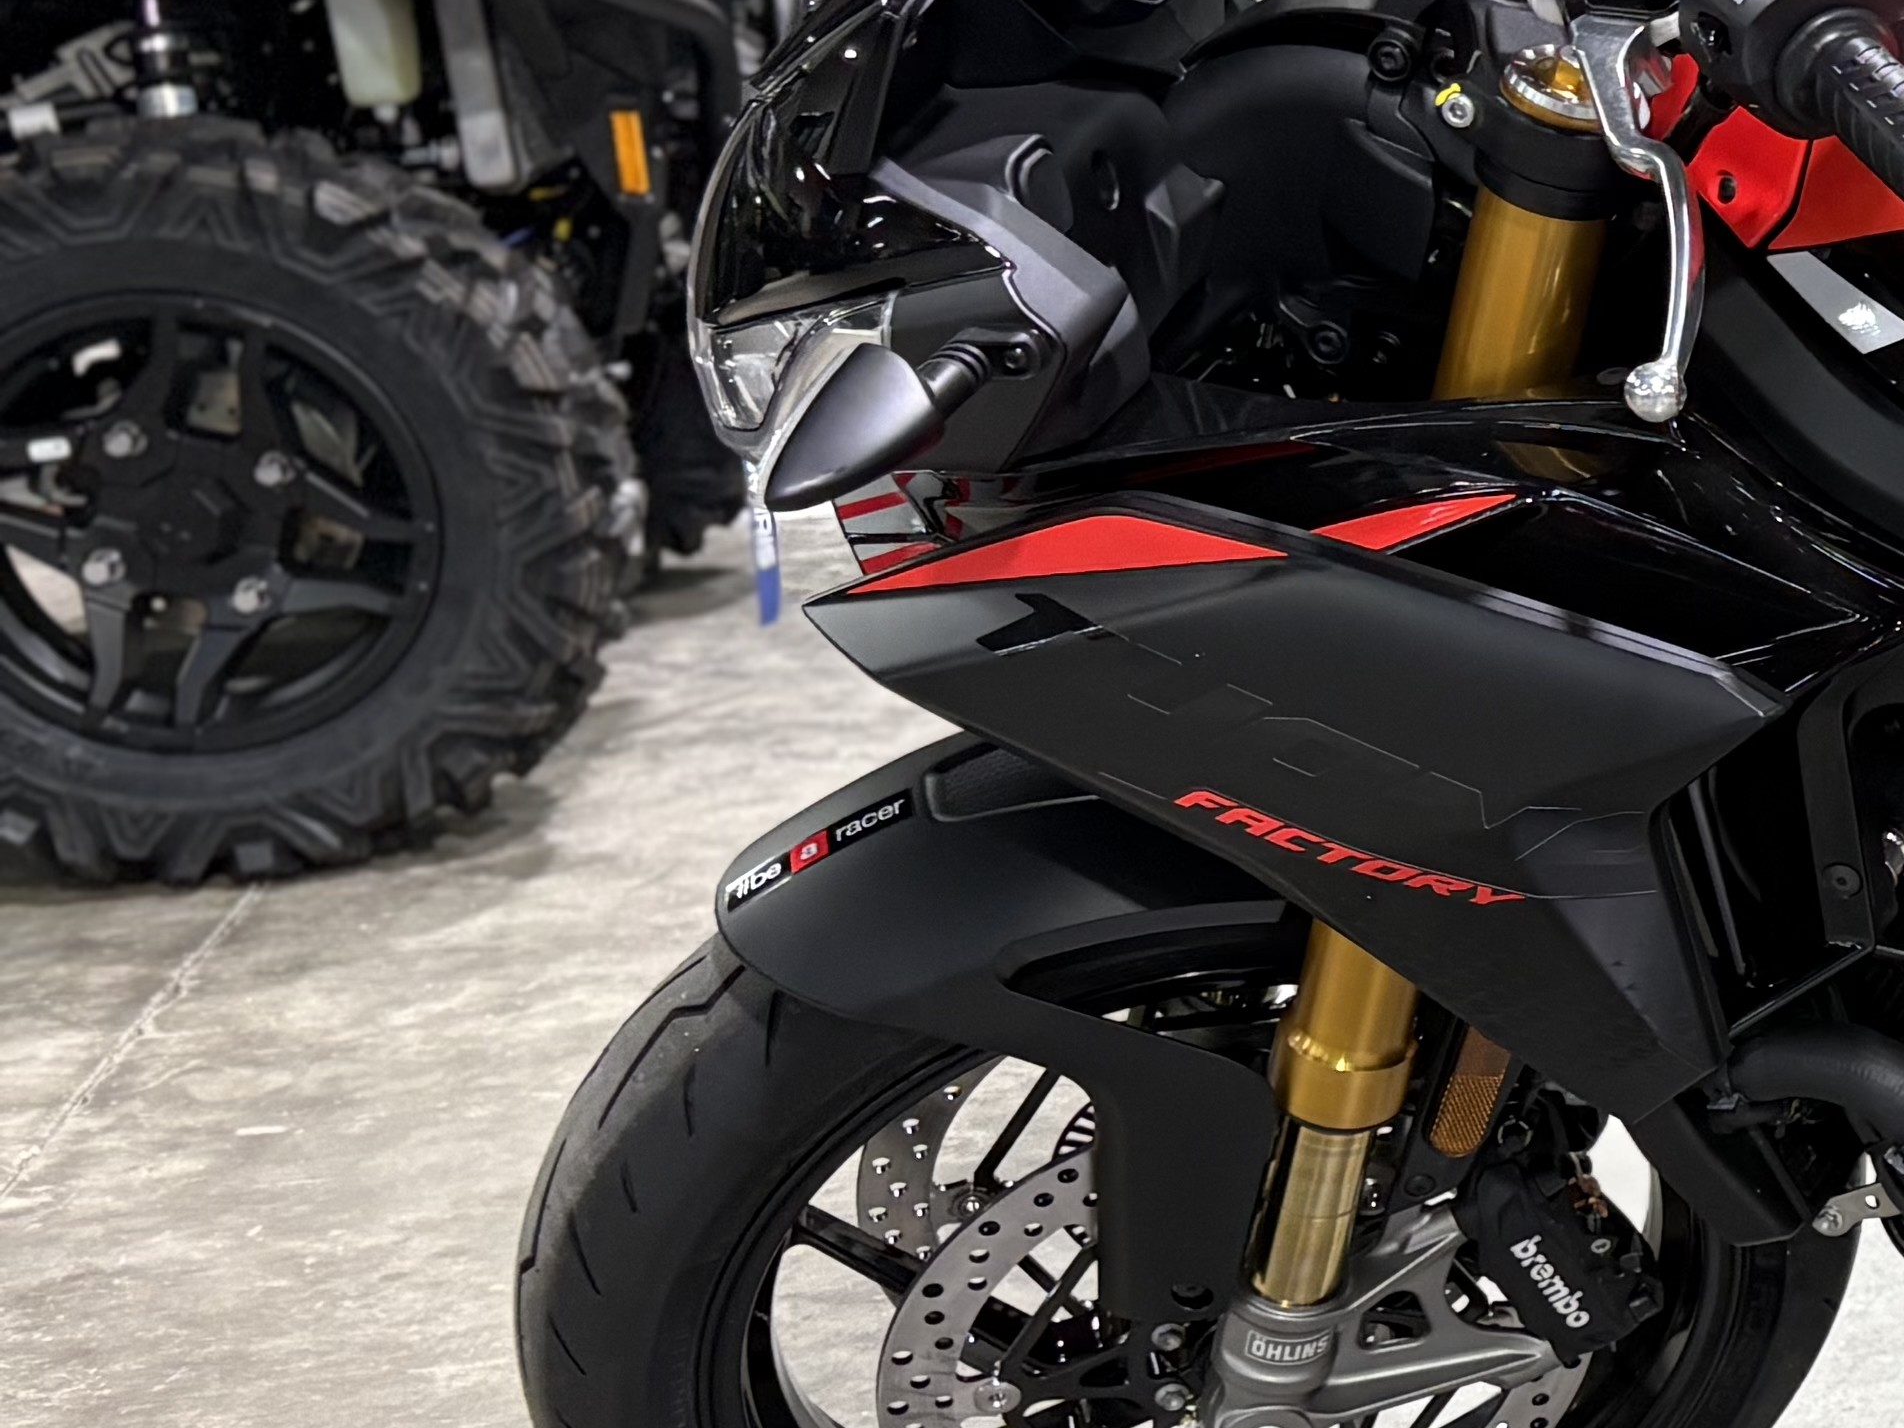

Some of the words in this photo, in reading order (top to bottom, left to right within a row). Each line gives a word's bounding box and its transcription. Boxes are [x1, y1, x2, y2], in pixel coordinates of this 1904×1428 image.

[835, 799, 905, 842] racer
[1174, 790, 1526, 905] FACTORY
[1510, 1235, 1591, 1329] brembo
[1251, 1334, 1329, 1361] ÖHLINS
